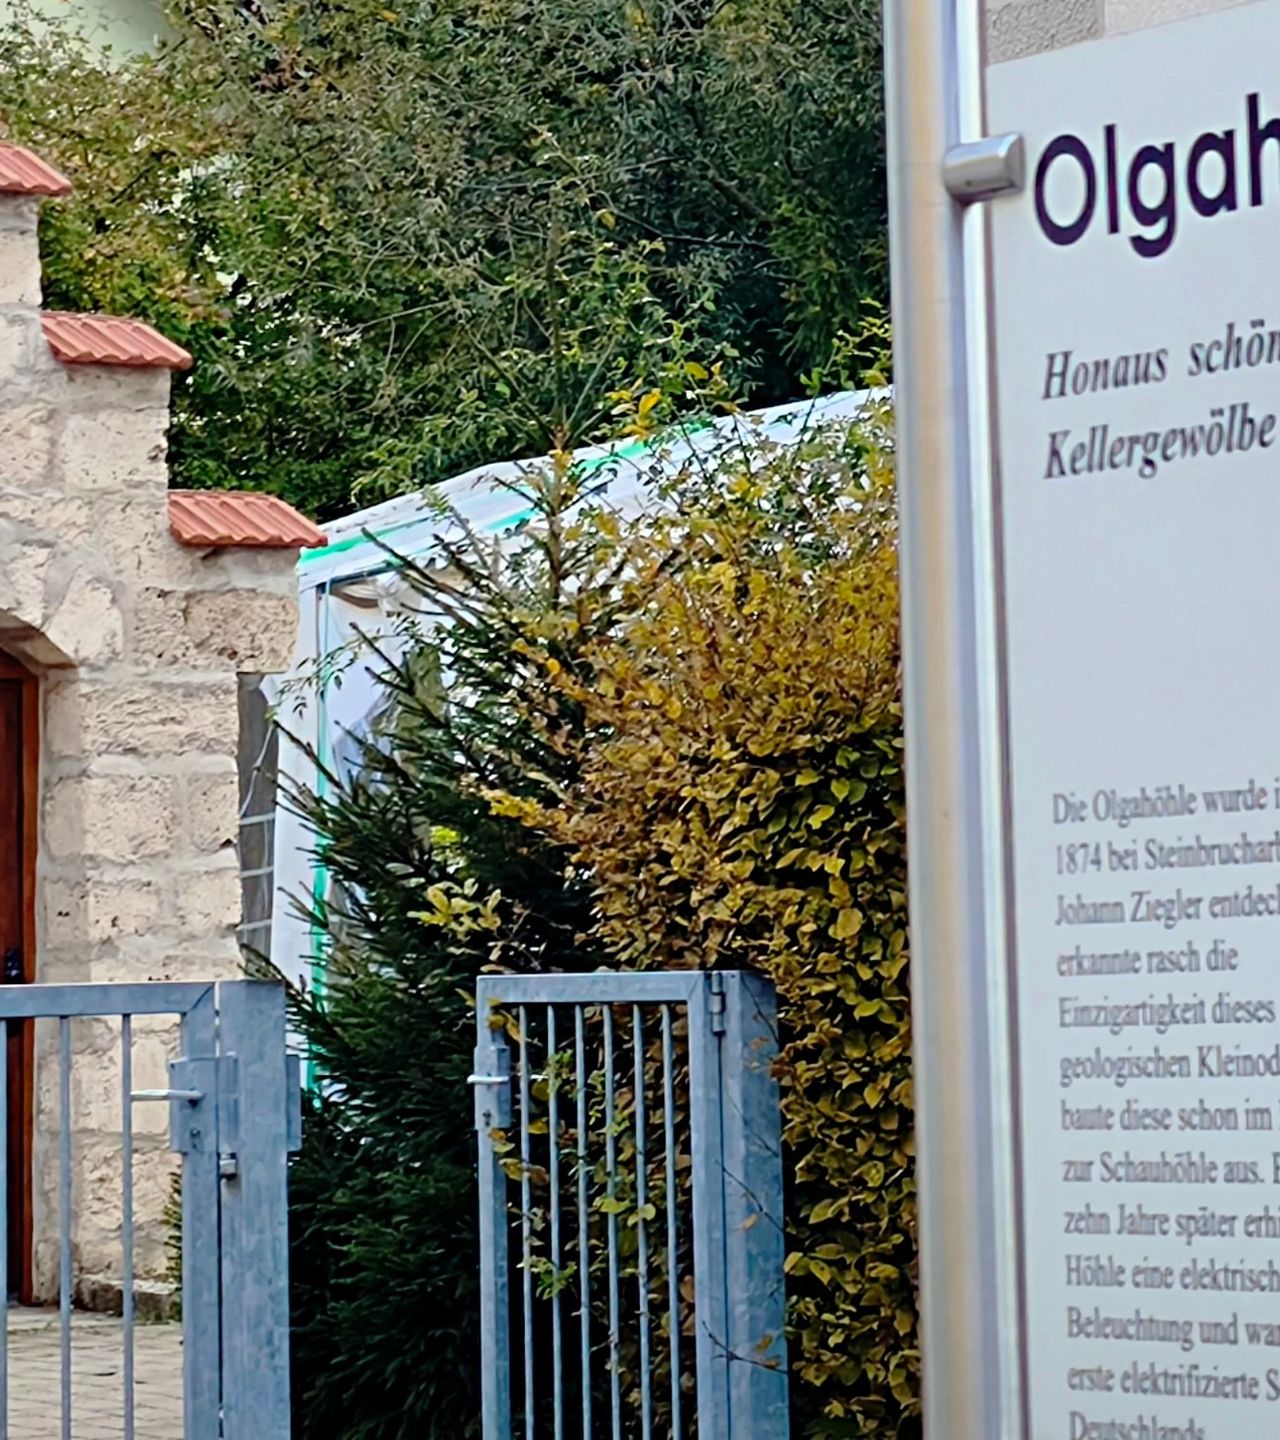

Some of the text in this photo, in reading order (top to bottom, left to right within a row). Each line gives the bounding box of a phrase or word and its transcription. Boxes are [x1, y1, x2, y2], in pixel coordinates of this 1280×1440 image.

[1040, 348, 1168, 401] Honaus
[1043, 401, 1277, 481] Kellergewölbe
[1052, 792, 1088, 825] Die
[1092, 783, 1198, 829] Olgahöhle
[1202, 778, 1267, 814] wurde
[1055, 842, 1102, 875] 1874
[1108, 837, 1138, 872] bei
[1055, 893, 1126, 925] Johann
[1130, 888, 1202, 930] Ziegler
[1057, 938, 1239, 977] erkannte rasch die
[1058, 991, 1276, 1036] Einzigartigkeit dieses
[1059, 1045, 1191, 1088] geologischen
[1061, 1099, 1115, 1131] baute
[1120, 1099, 1172, 1131] diese
[1177, 1099, 1239, 1131] schon
[1245, 1098, 1273, 1131] im
[1063, 1159, 1093, 1183] zur
[1099, 1150, 1218, 1184] Schauhöhle
[1223, 1160, 1265, 1184] aus.
[1064, 1202, 1111, 1235] zehn
[1116, 1202, 1170, 1236] Jahre
[1175, 1206, 1238, 1246] später
[1065, 1254, 1126, 1288] Höhle
[1132, 1256, 1174, 1289] eine
[1067, 1306, 1194, 1352] Beleuchtung
[1199, 1312, 1239, 1345] und
[1067, 1366, 1115, 1392] erste
[1120, 1361, 1259, 1400] elektrifizierte
